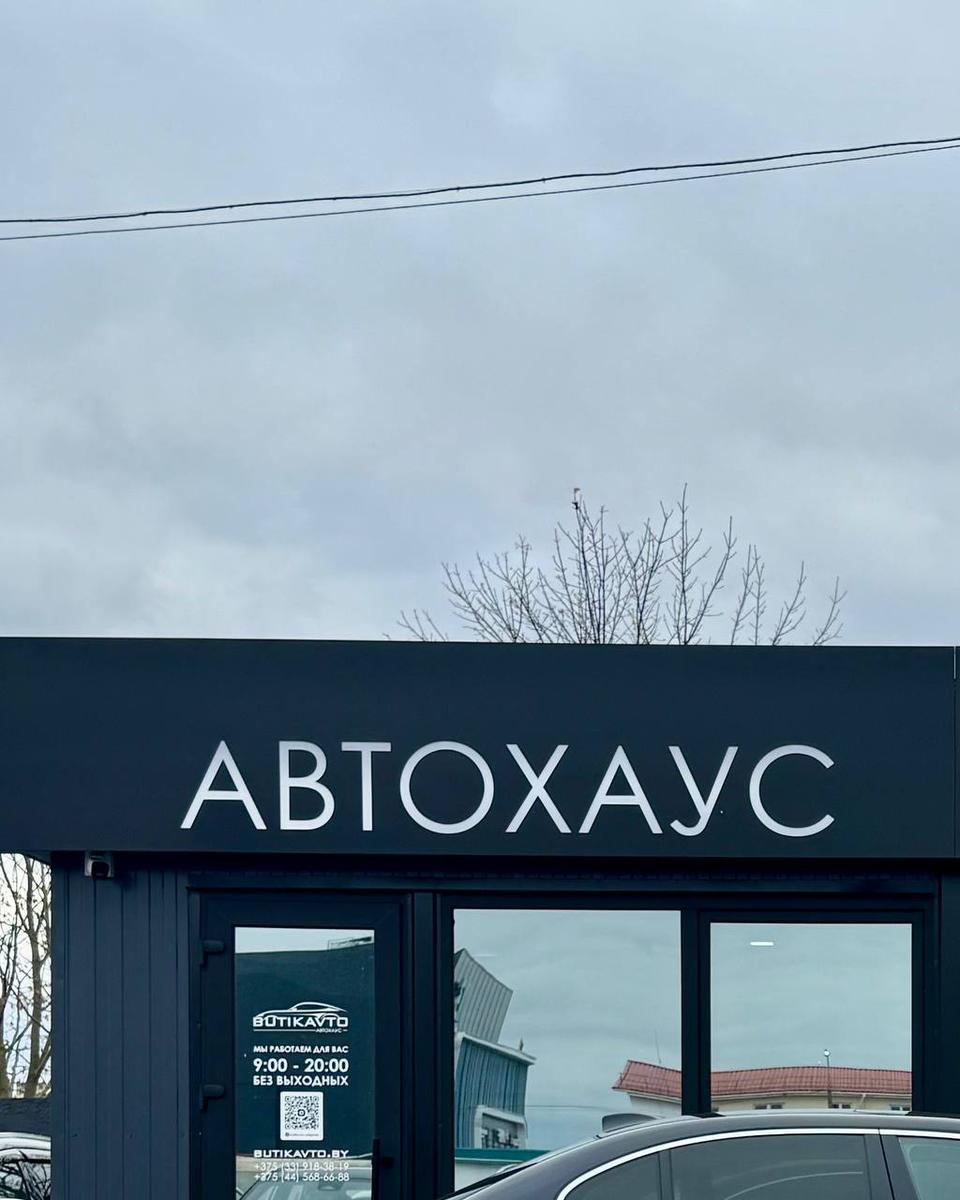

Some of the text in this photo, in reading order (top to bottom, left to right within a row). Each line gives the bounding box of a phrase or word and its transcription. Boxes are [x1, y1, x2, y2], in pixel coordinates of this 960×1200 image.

[181, 739, 835, 837] АВТОХАУС
[253, 1016, 349, 1027] BUTIKAVTO
[253, 1058, 288, 1073] 9:00
[304, 1058, 349, 1073] 20:00
[253, 1075, 349, 1087] БЕЗ ВЫХОДНЫХ
[253, 1149, 350, 1158] BUTIKAVTO.BY
[254, 1161, 350, 1172] +375 (33) 918-38-19
[254, 1172, 350, 1183] +375 (44) 568-66-88
